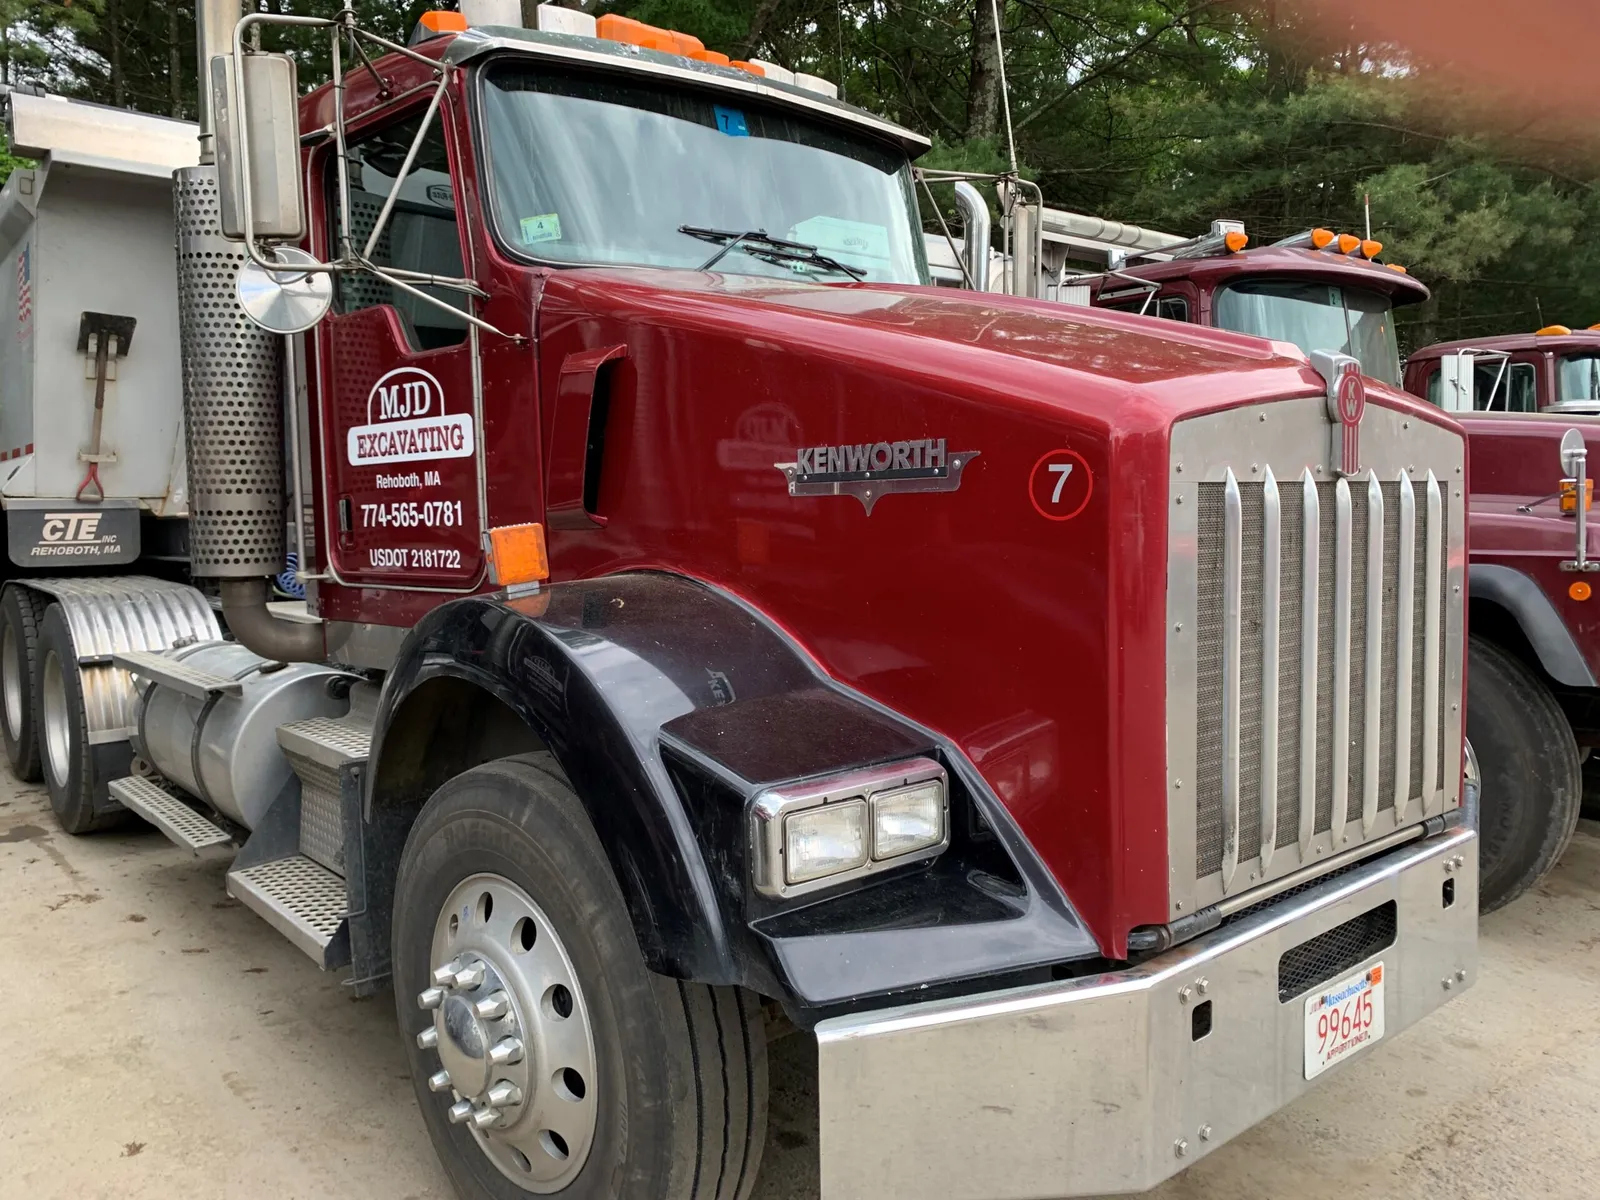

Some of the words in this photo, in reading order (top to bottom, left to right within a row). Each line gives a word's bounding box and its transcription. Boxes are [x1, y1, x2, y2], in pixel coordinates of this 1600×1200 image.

[720, 114, 729, 130] 7
[378, 381, 431, 420] MJD
[356, 423, 465, 458] EXCAVATING
[796, 438, 947, 475] KENWORTH
[376, 472, 423, 489] Rehoboth,
[424, 471, 441, 487] MA
[1048, 463, 1073, 503] 7
[42, 513, 103, 541] CTE
[361, 500, 463, 527] 774-565-0781
[30, 545, 101, 556] REHOBOTH,
[104, 545, 121, 554] MA
[102, 535, 117, 543] INC
[369, 549, 408, 567] USDOT
[411, 549, 461, 568] 2181722
[1318, 989, 1372, 1054] 99645
